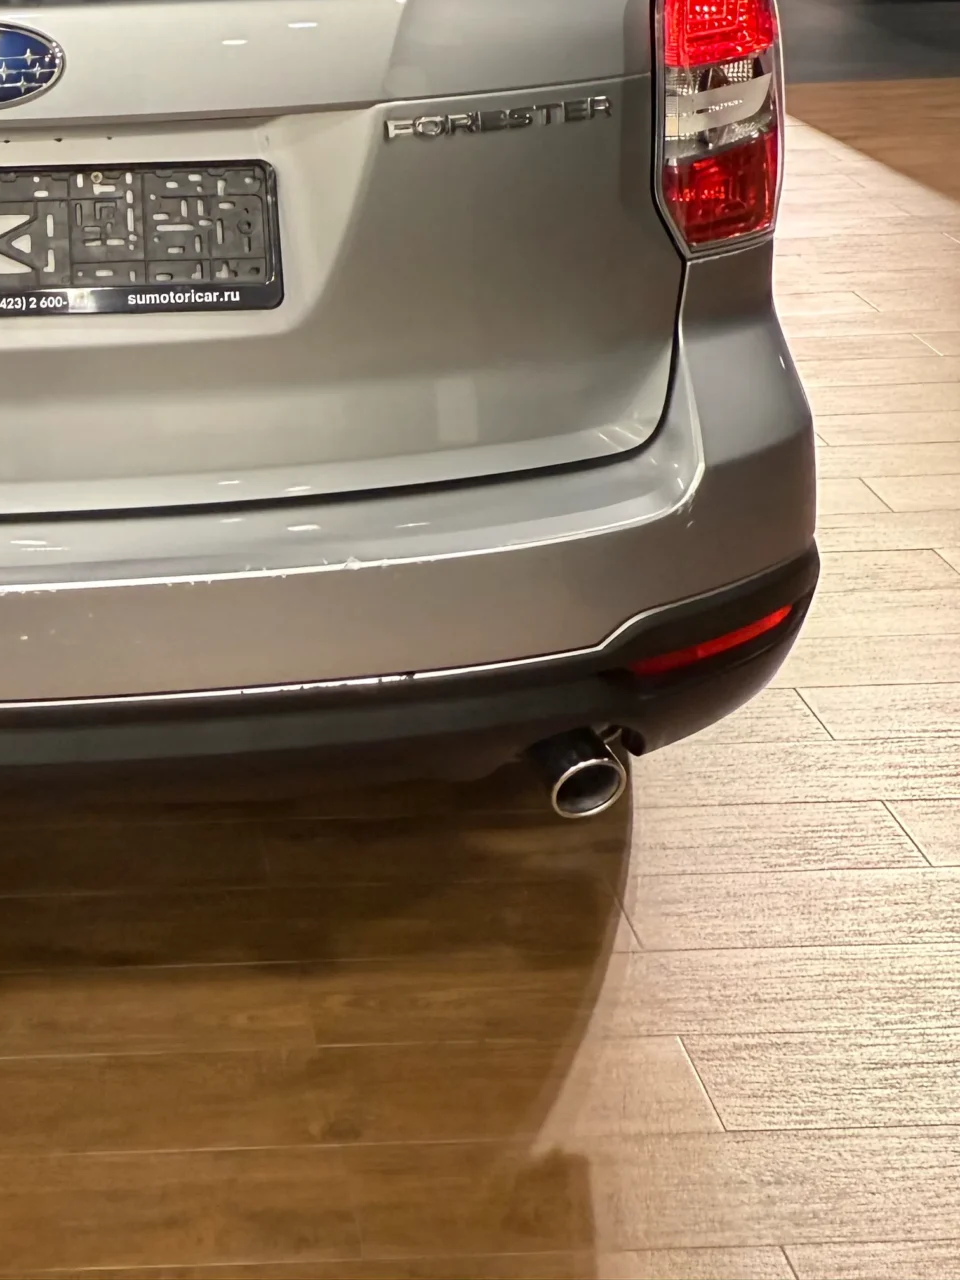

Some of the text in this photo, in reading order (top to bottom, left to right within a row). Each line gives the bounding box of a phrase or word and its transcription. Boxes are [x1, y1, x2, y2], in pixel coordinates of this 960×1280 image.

[384, 96, 613, 140] FORESTER
[28, 297, 37, 308] 2
[127, 289, 240, 305] sumotoricar.ru
